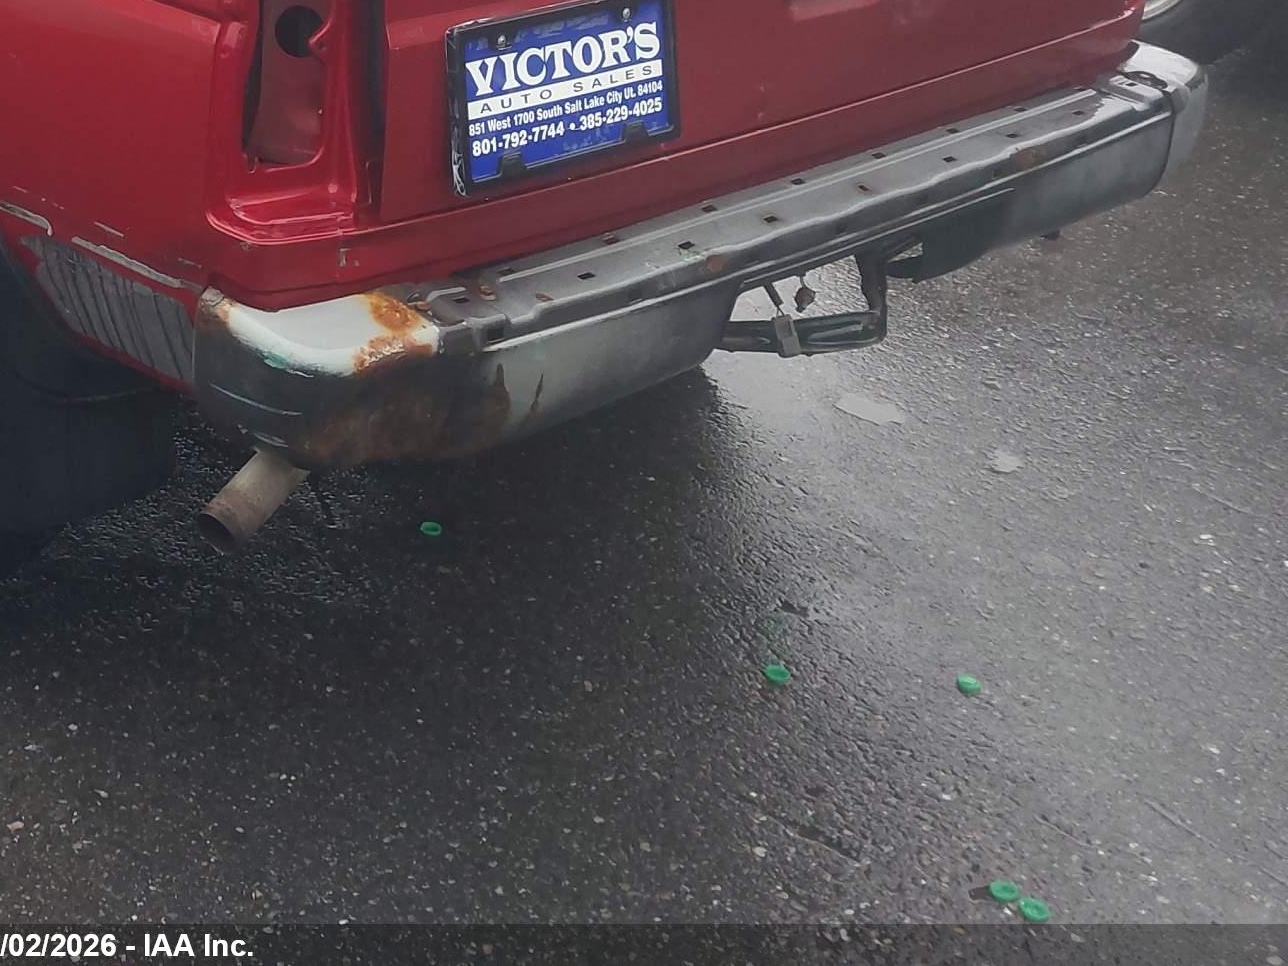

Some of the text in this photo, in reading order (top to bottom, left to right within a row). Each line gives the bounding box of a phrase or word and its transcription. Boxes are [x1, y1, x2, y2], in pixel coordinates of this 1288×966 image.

[465, 21, 661, 97] VICTOR'S
[469, 122, 487, 138] 851
[487, 115, 511, 134] West
[513, 109, 536, 127] 1700
[536, 103, 563, 122] South
[564, 98, 584, 116] Salt
[584, 93, 605, 111] Lake
[606, 87, 623, 109] City
[637, 80, 663, 97] 84104
[479, 64, 654, 115] AUTO SALES
[472, 97, 663, 158] 801-792-7744 385-229-4025
